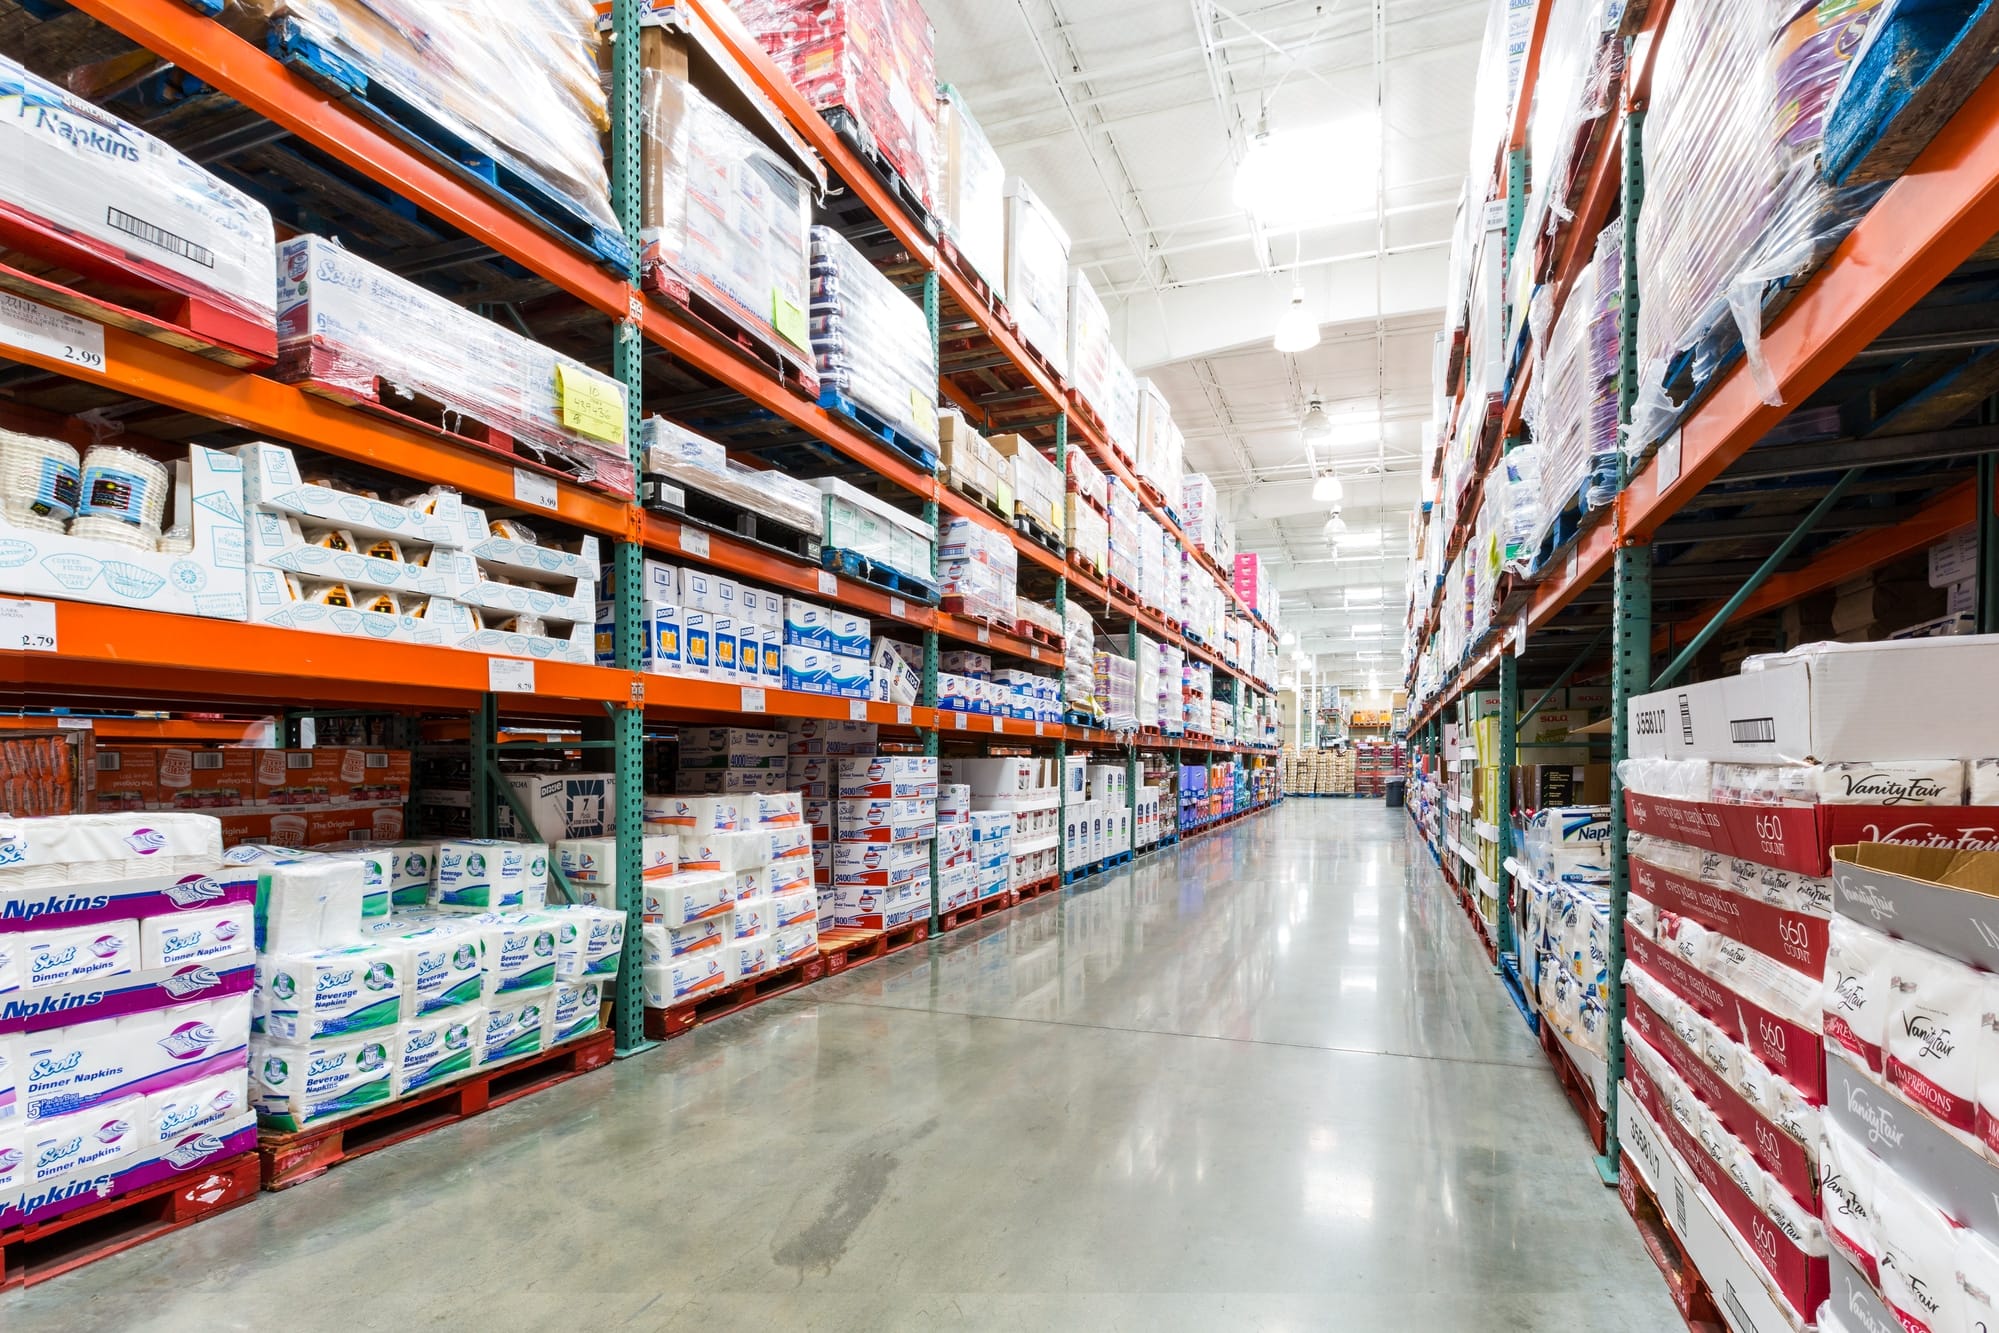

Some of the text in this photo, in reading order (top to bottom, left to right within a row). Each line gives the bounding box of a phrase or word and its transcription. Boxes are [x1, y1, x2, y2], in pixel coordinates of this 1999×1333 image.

[1509, 41, 1526, 53] 400
[36, 108, 140, 163] Napkins
[64, 345, 101, 366] 2.99
[540, 495, 556, 507] 3.99
[1540, 714, 1568, 723] SOLO
[1636, 709, 1667, 735] 3558117
[839, 787, 856, 796] 2400
[222, 826, 248, 836] riginal
[328, 820, 355, 829] Original
[839, 830, 856, 838] 2400
[1578, 826, 1611, 841] Napk
[1756, 815, 1783, 840] 660
[1761, 840, 1785, 856] COUNT
[440, 853, 462, 868] Scott
[439, 869, 463, 878] Beverage
[835, 873, 851, 882] 2400
[1665, 879, 1740, 917] everyday napkins
[163, 931, 202, 955] Scott
[1780, 917, 1808, 948] 660
[164, 943, 232, 964] Dinner Napkins
[501, 935, 528, 953] Scott
[1783, 943, 1811, 964] COUNT
[32, 945, 77, 973] Scott
[417, 952, 446, 976] Scott
[501, 953, 529, 962] Beverage
[32, 960, 114, 983] Dinner Napkins
[316, 969, 354, 992] Scott
[416, 971, 449, 985] Beverage
[315, 989, 358, 1001] Beverage
[1688, 968, 1724, 1008] napkins
[314, 998, 348, 1008] Napkins
[557, 990, 579, 1008] Scott
[486, 1012, 514, 1034] Scott
[1760, 1016, 1785, 1051] 660
[405, 1031, 437, 1054] Scott
[28, 1050, 83, 1081] Scott
[307, 1052, 347, 1076] Scott
[404, 1050, 439, 1063] Beverage
[1763, 1044, 1787, 1069] COUNT
[28, 1066, 123, 1093] Dinner Napkins
[306, 1072, 350, 1087] Beverage
[306, 1082, 339, 1094] Napkins
[27, 1100, 41, 1119] 5
[160, 1104, 199, 1131] Scott
[1755, 1120, 1780, 1159] 660
[37, 1136, 82, 1168] Scott
[37, 1144, 121, 1179] Dinner Napkins
[1753, 1216, 1776, 1258] 660
